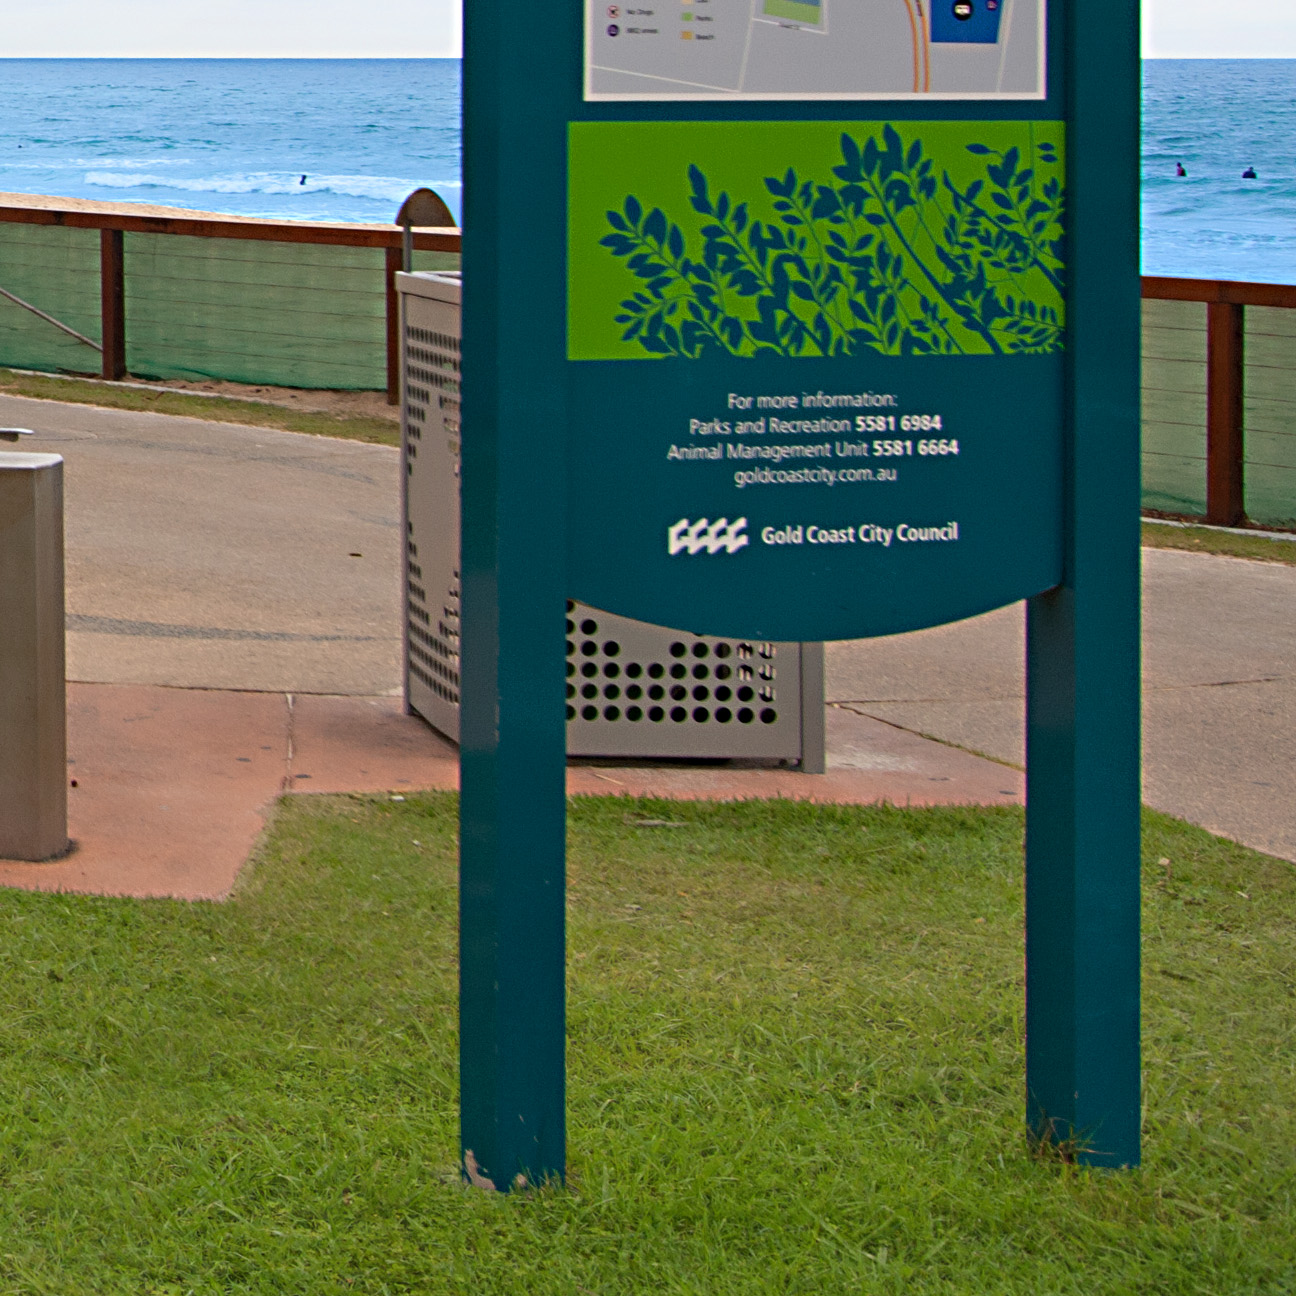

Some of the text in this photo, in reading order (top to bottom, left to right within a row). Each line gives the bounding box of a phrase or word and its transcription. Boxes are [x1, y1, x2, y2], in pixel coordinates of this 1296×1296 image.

[727, 390, 899, 410] For more information:
[689, 414, 942, 435] Parks and Recreation 5581 6984
[667, 439, 959, 463] Animal Management Unit 5581 6664
[734, 465, 897, 488] goldcoastcity.com.au
[761, 521, 959, 547] Gold Coast City Council
